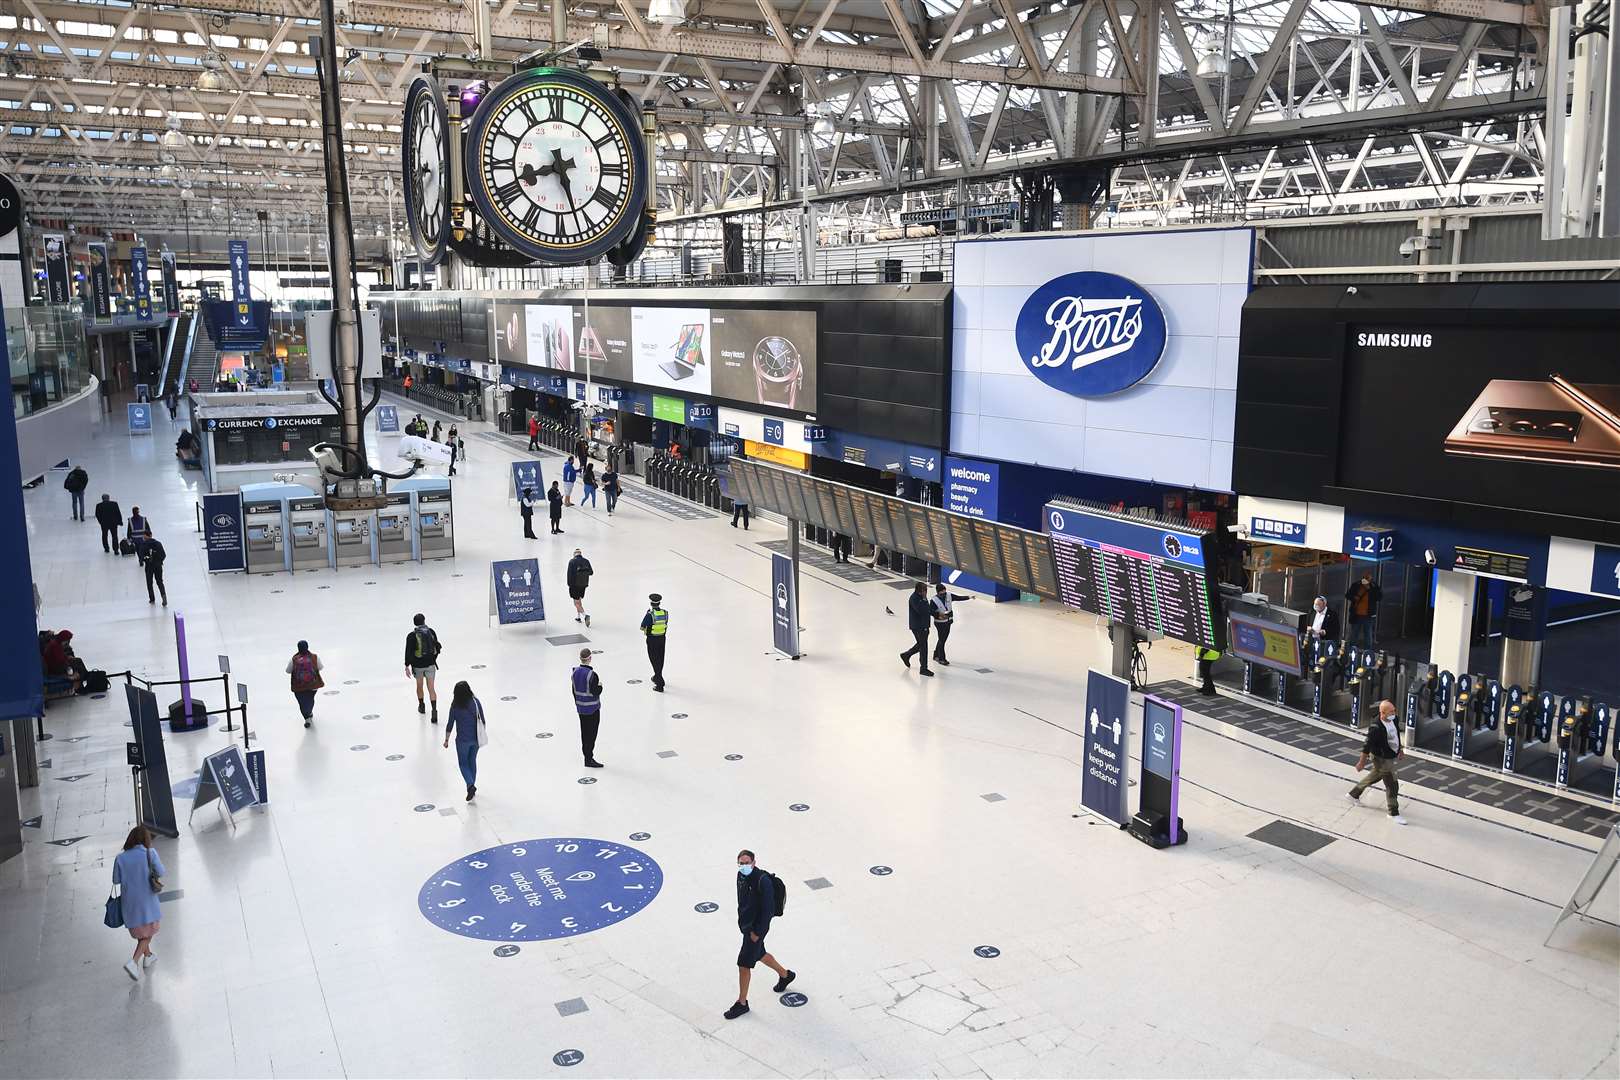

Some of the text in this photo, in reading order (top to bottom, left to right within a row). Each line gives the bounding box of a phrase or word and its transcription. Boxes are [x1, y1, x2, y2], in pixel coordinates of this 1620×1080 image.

[1031, 295, 1143, 371] Boots
[1357, 333, 1433, 348] SAMSUNG
[701, 408, 712, 416] 10
[218, 418, 322, 428] CURRENCY EXCHANGE
[814, 429, 826, 438] 11
[950, 467, 990, 482] welcome
[950, 483, 978, 494] pharmacy
[950, 493, 969, 504] beauty
[950, 502, 963, 512] food
[969, 506, 984, 516] drink
[1354, 536, 1375, 552] 12
[1380, 536, 1392, 552] 12
[1094, 742, 1116, 760] Please
[1088, 752, 1120, 774] keep your
[1090, 766, 1118, 786] distance
[512, 848, 527, 857] 9
[554, 844, 579, 853] 10
[595, 848, 620, 860] 11
[468, 860, 488, 869] 8
[620, 862, 644, 875] 12
[441, 880, 462, 889] 7
[510, 872, 542, 907] under the
[536, 867, 567, 900] Meet me
[490, 884, 514, 904] clock
[600, 902, 623, 912] 2
[461, 915, 485, 927] 5
[561, 916, 578, 928] 3
[510, 922, 528, 934] 4
